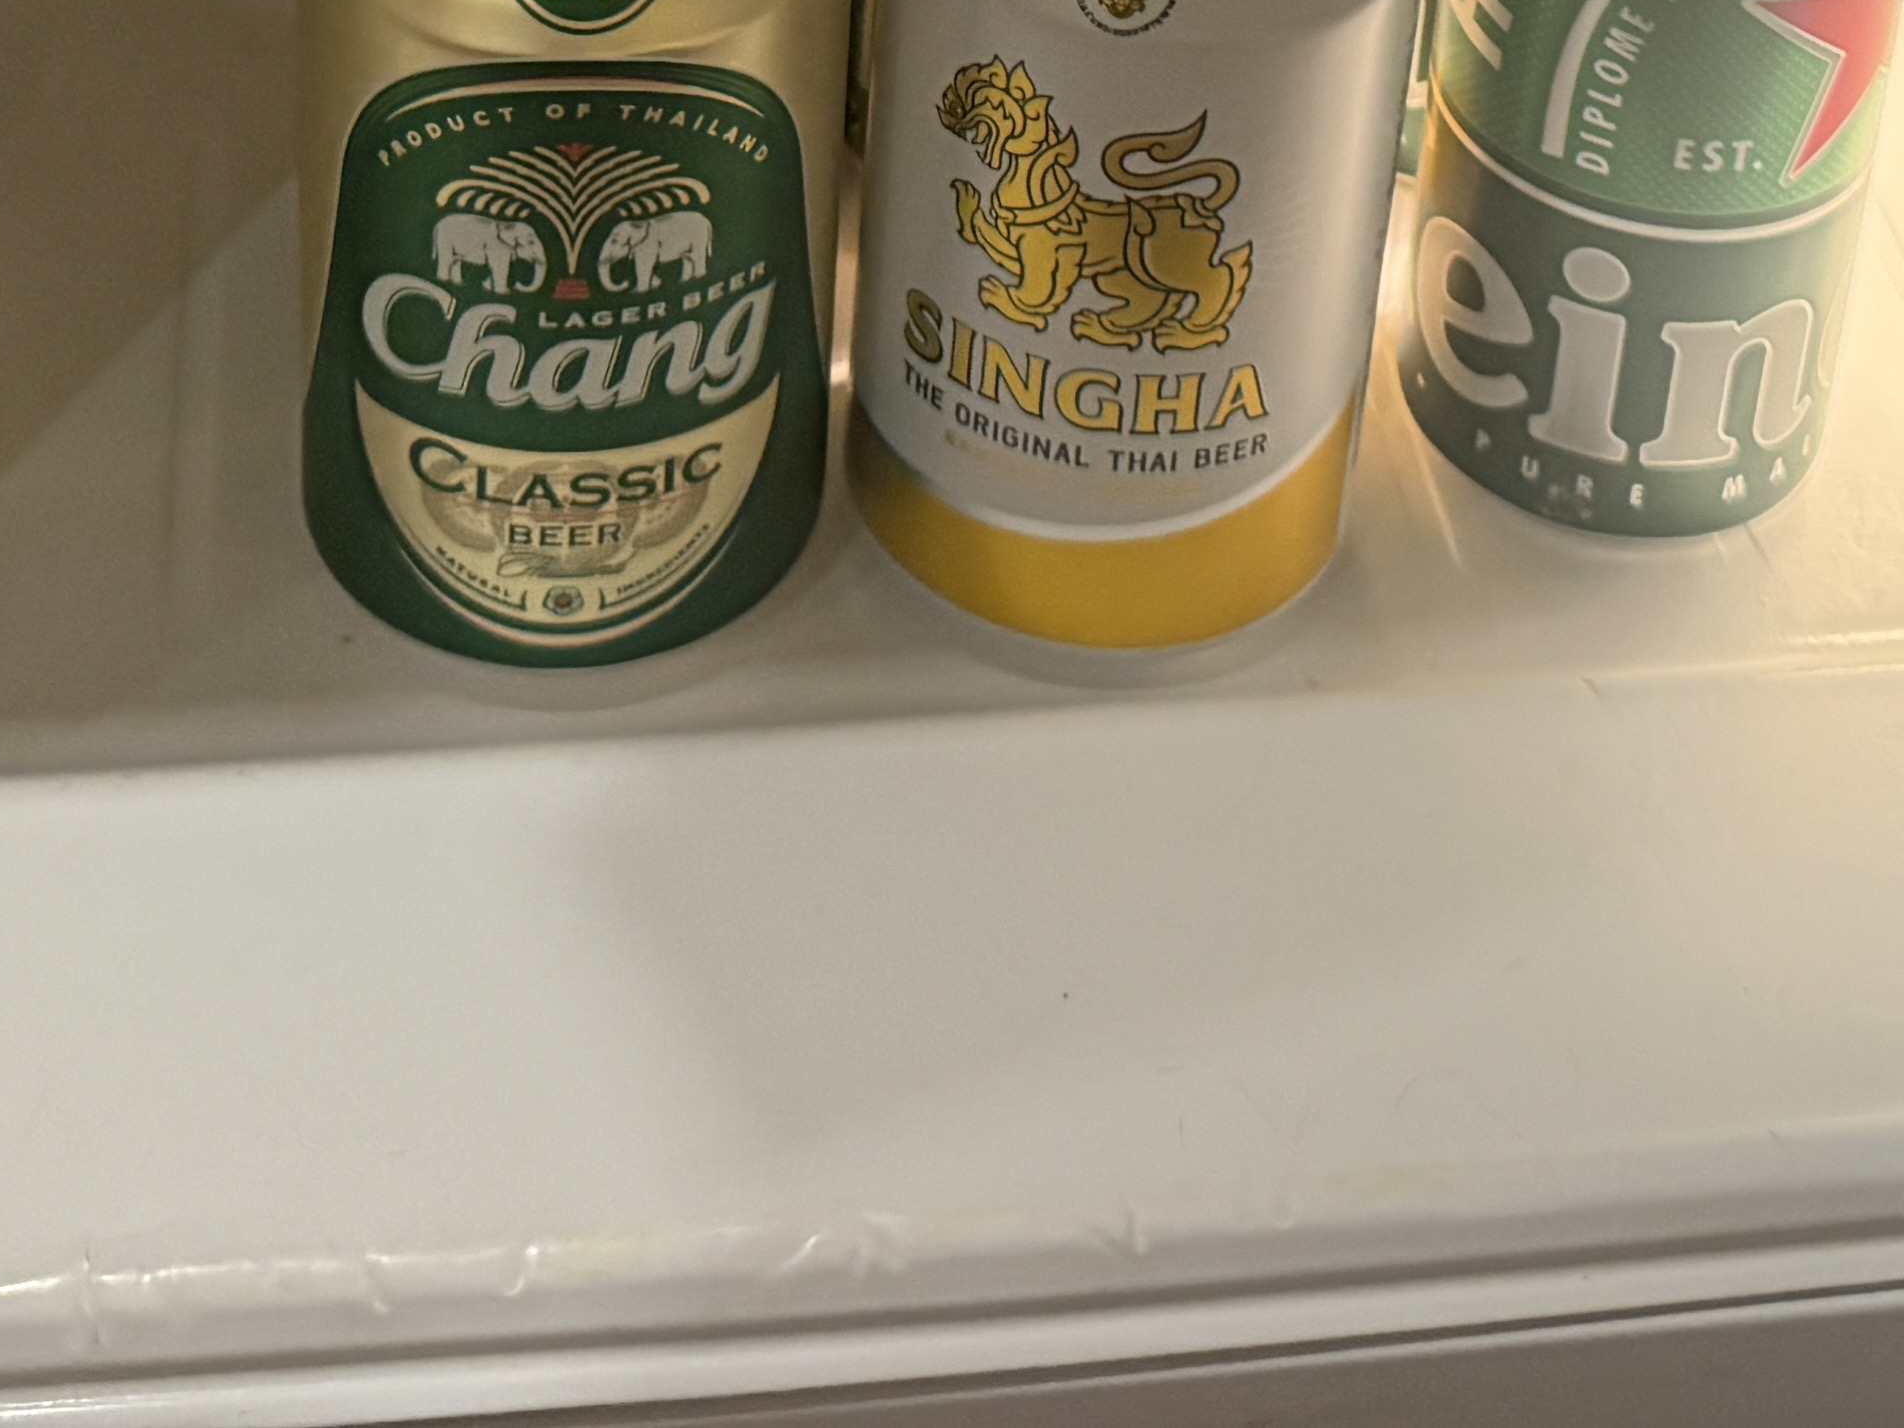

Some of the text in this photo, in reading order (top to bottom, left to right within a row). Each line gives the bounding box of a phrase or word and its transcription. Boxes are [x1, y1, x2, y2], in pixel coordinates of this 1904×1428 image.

[377, 103, 770, 169] PRODUCT OF THAILAND
[1576, 7, 1654, 177] DIPLOME
[1673, 138, 1763, 172] EST.
[360, 272, 777, 412] Chang
[538, 262, 768, 329] LAGER BEER
[1416, 215, 1816, 468] ein
[902, 286, 1271, 436] SINGHA
[902, 359, 944, 413] THE
[955, 402, 1089, 469] ORIGINAL
[1107, 447, 1179, 473] THAI
[1193, 433, 1269, 469] BEER
[1475, 428, 1645, 507] PURE
[507, 521, 623, 549] BEER
